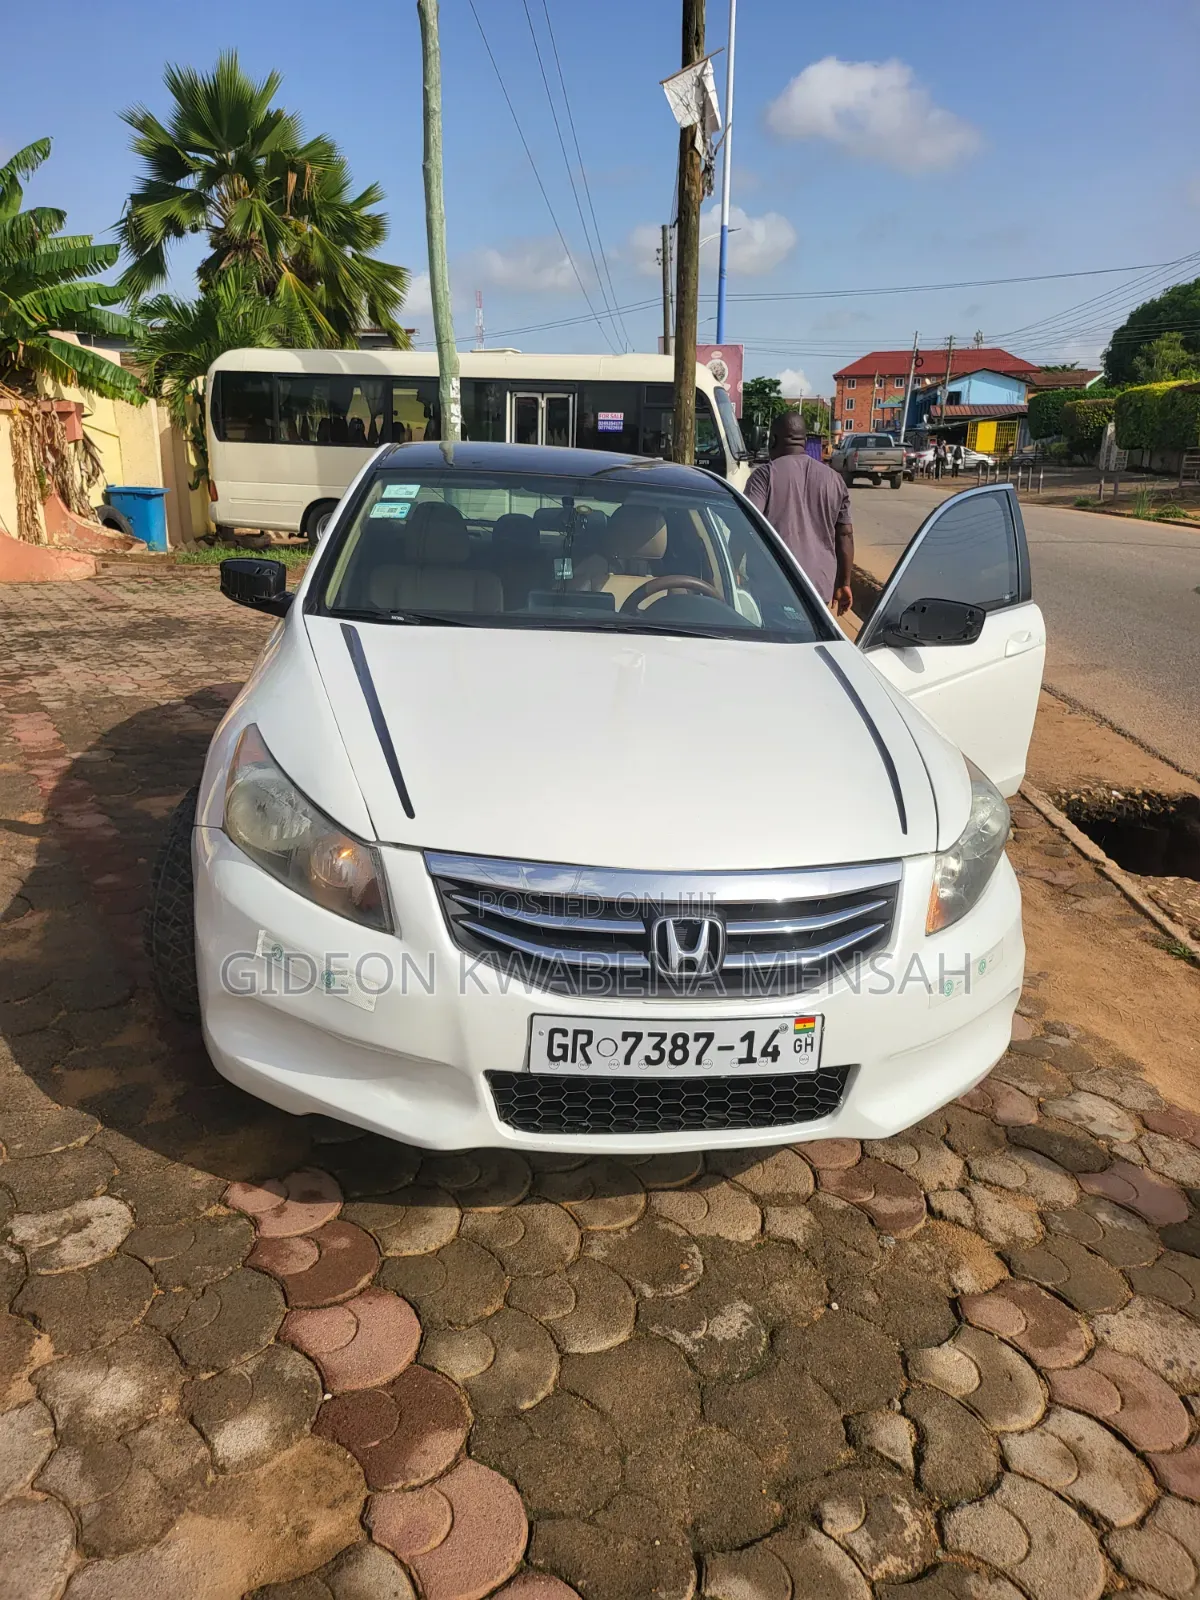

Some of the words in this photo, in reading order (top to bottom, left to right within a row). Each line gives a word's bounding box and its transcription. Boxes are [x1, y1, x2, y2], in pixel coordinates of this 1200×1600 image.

[547, 1027, 593, 1065] GR
[621, 1029, 781, 1066] 7387-14
[793, 1036, 815, 1054] GH
